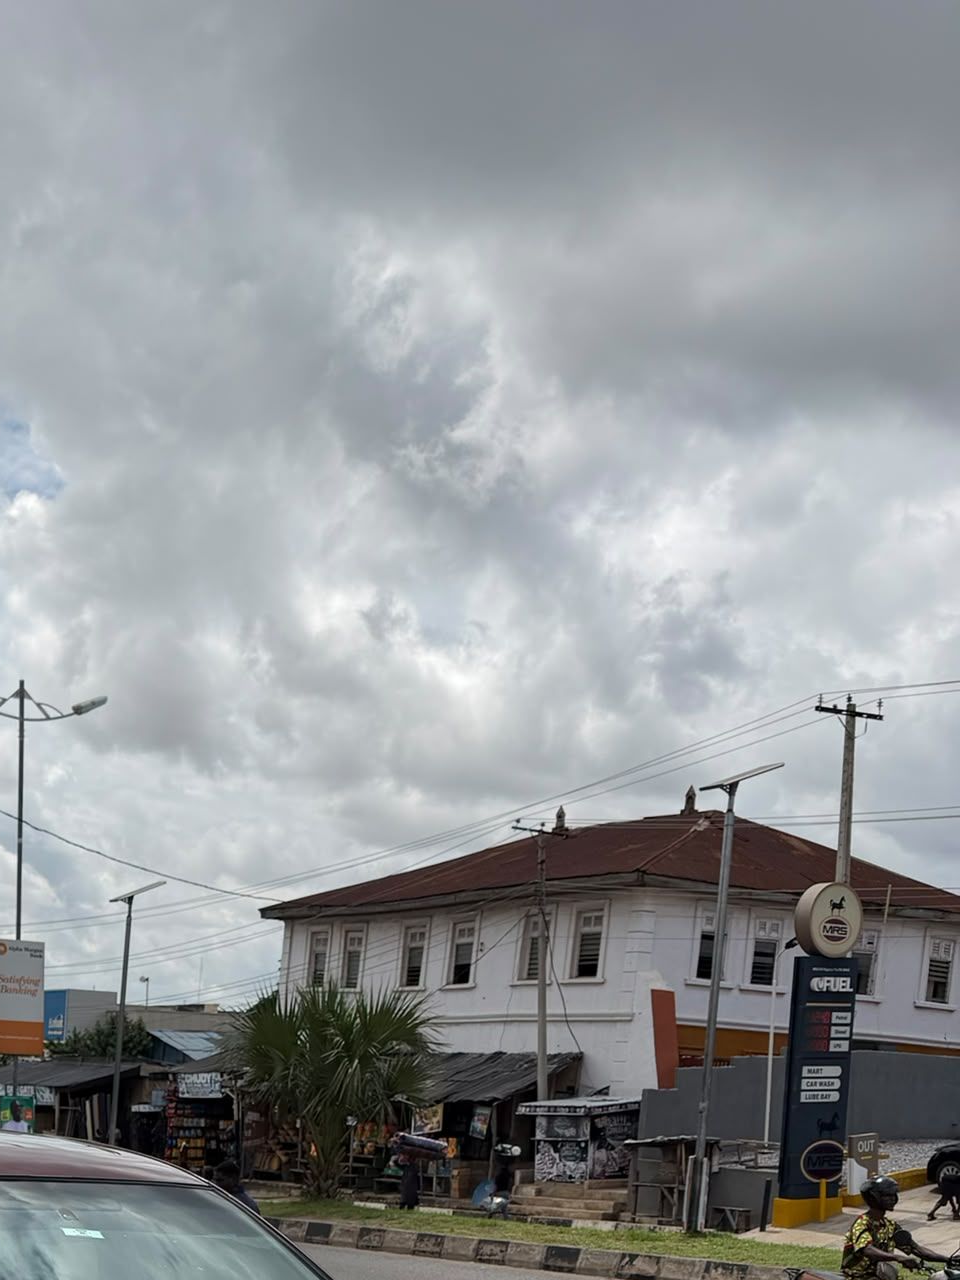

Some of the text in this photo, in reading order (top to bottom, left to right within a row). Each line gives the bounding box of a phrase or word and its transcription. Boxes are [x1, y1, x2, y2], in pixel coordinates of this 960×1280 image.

[822, 925, 848, 936] MRS
[0, 984, 39, 998] Banking
[857, 1140, 875, 1152] OUT
